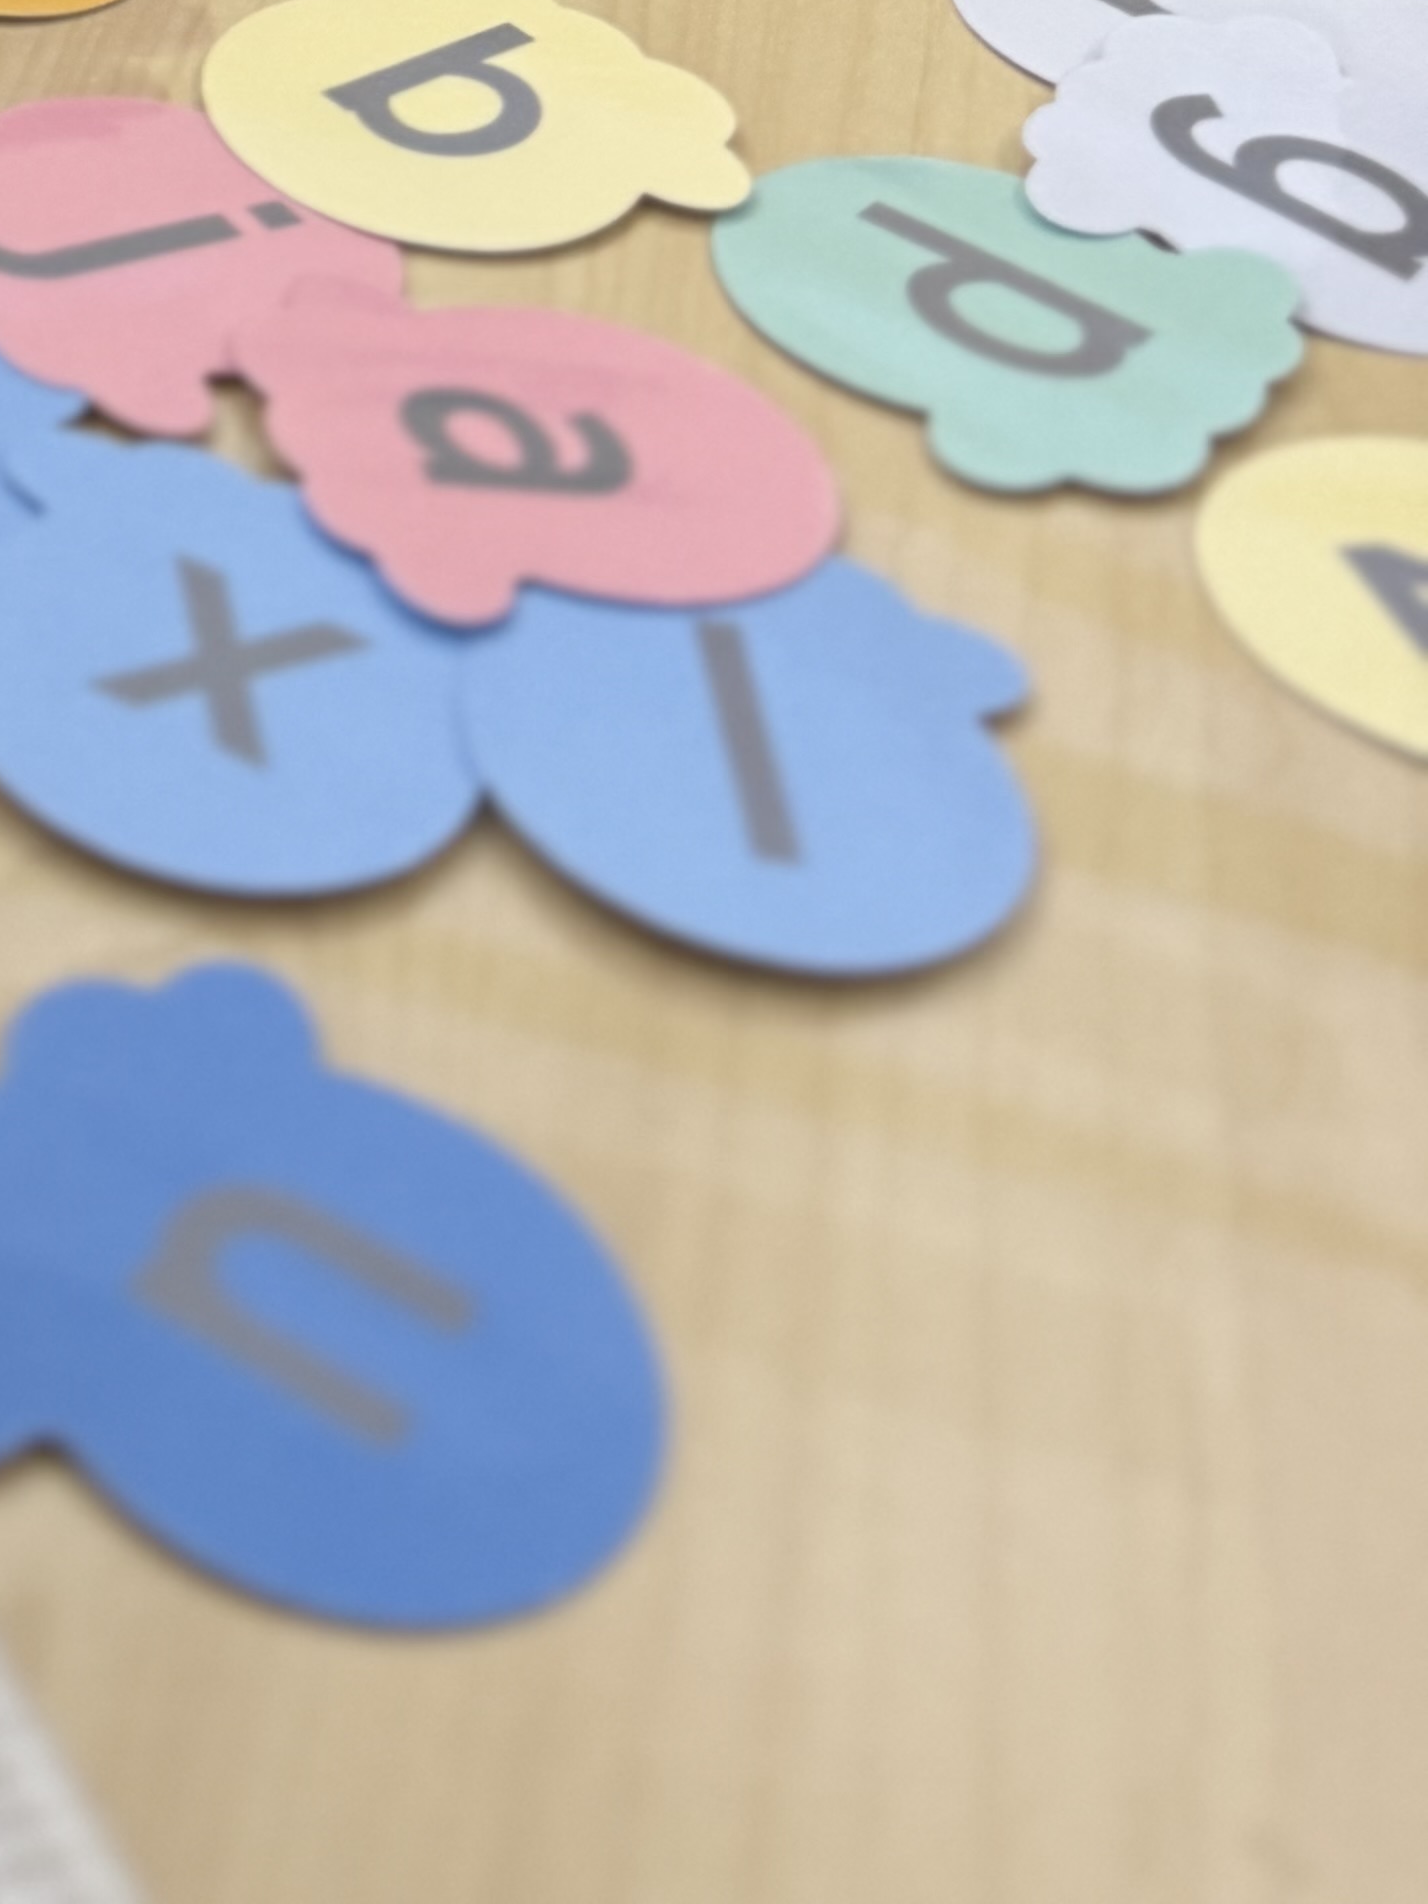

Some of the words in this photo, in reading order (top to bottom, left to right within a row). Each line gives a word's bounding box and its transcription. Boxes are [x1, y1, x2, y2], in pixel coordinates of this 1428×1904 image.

[1151, 93, 1428, 281] g
[398, 385, 635, 496] a
[88, 551, 372, 772] x
